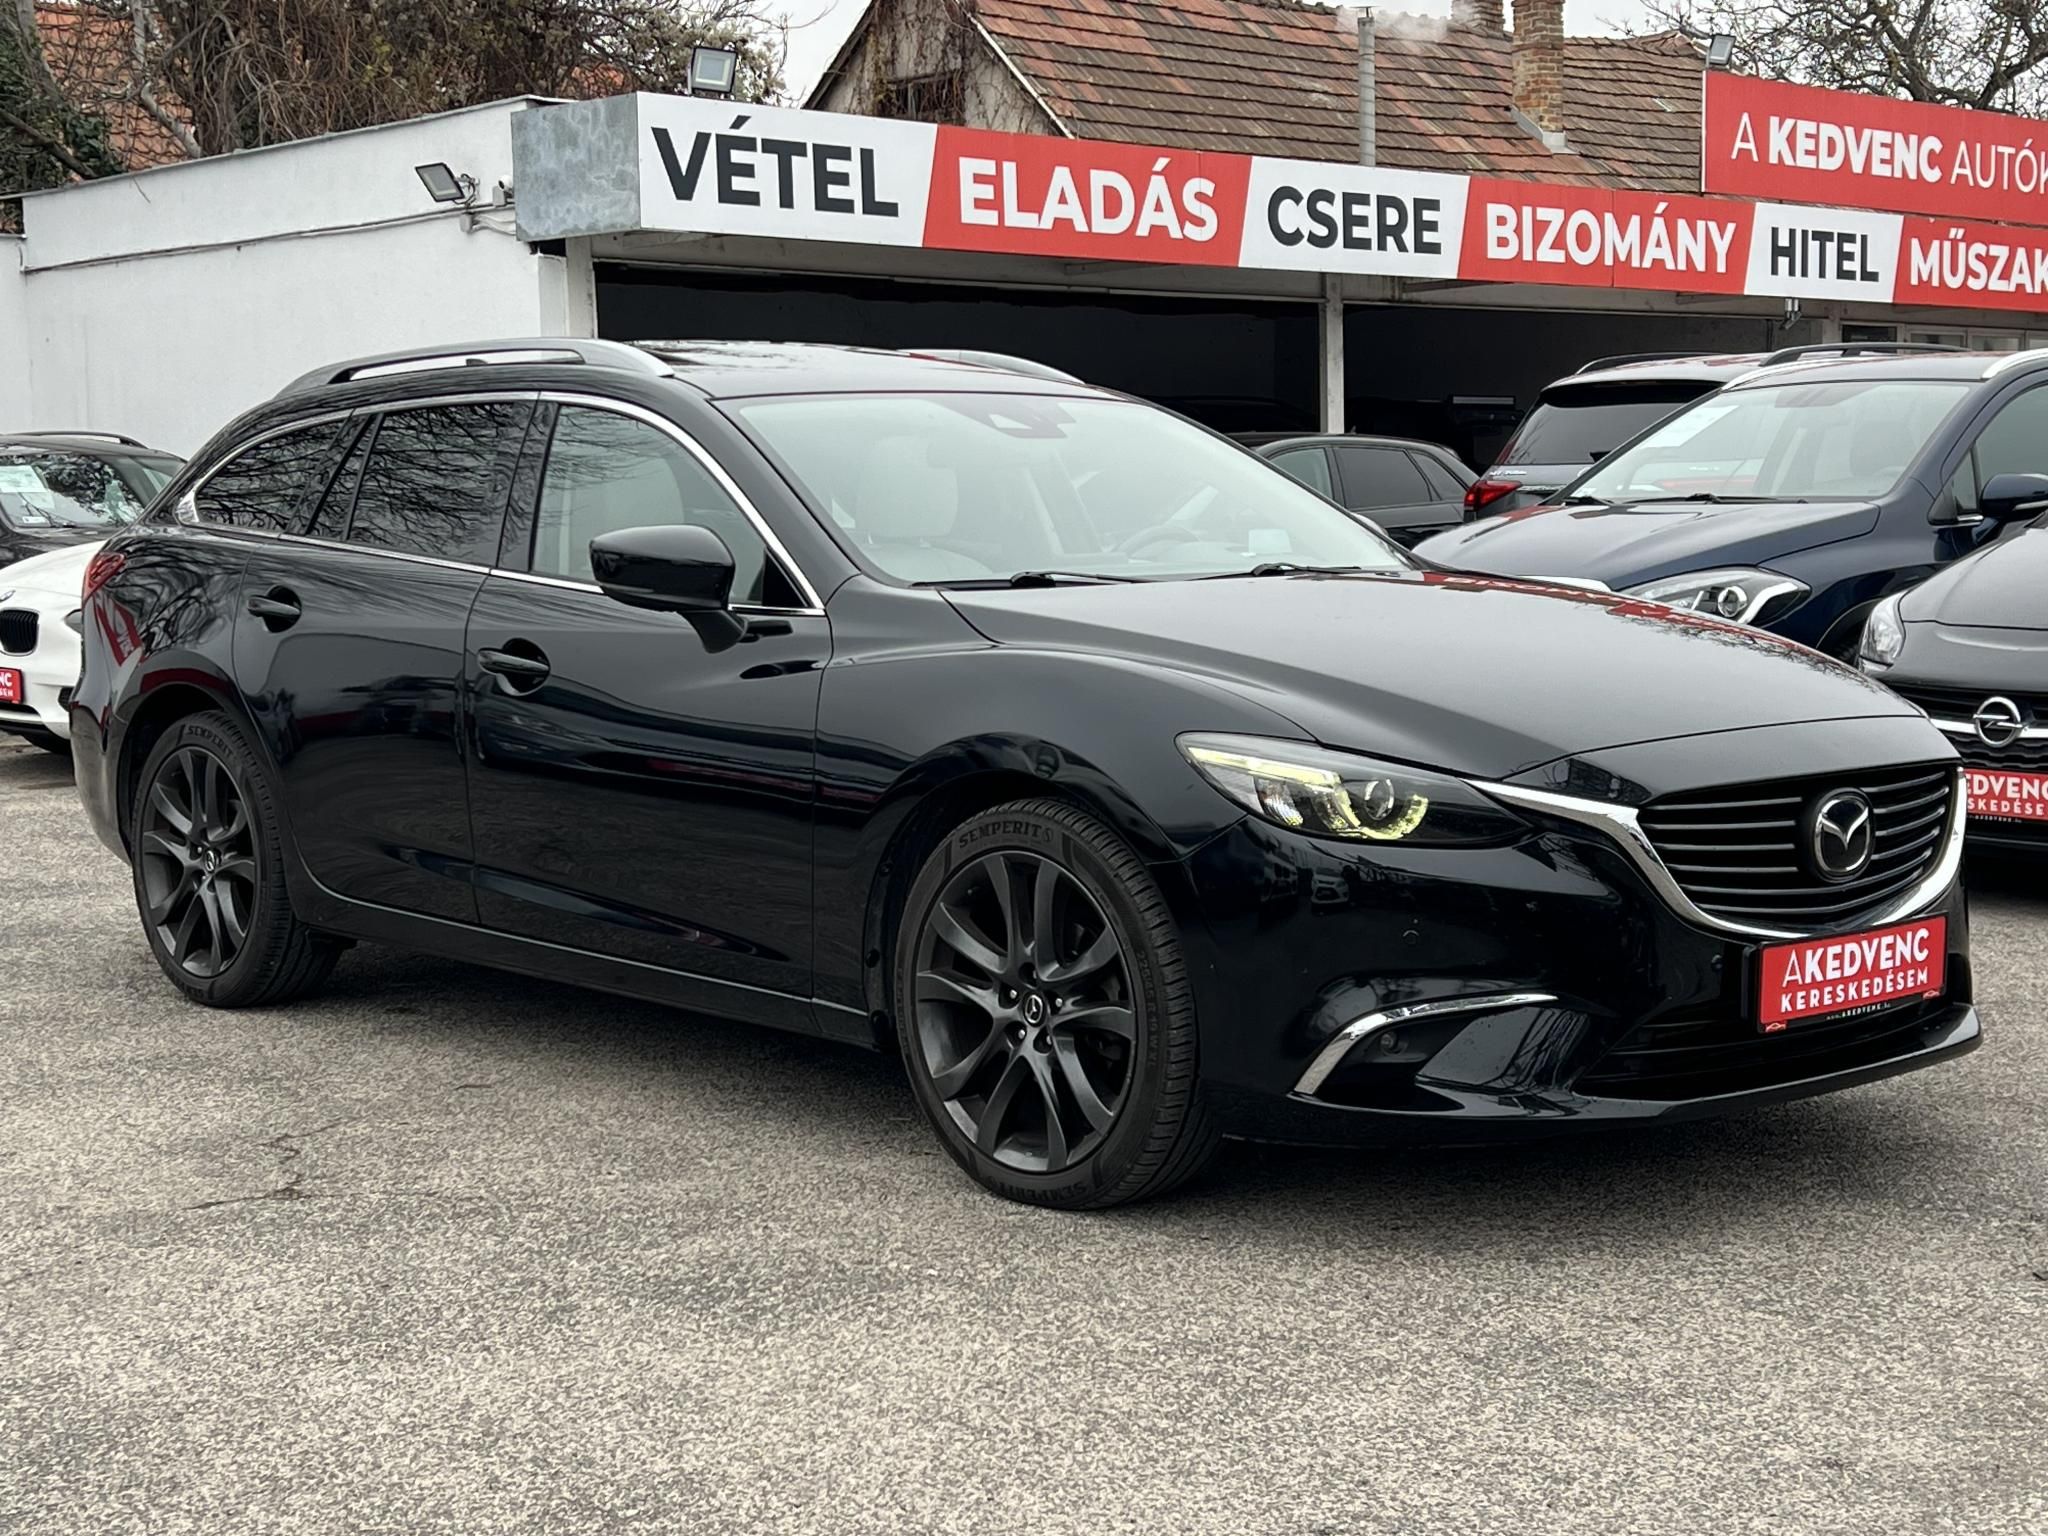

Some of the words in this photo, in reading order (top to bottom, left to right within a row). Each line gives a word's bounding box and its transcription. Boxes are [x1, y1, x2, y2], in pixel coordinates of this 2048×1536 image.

[1731, 112, 1759, 162] A
[1768, 116, 1943, 183] KEDVENC
[651, 115, 899, 217] VÉTEL
[958, 157, 1218, 242] ELADÁS
[1267, 186, 1442, 255] CSERE
[1486, 202, 1736, 274] BIZOMÁNY
[1771, 226, 1879, 283] HITEL
[1910, 227, 2048, 294] MŰSZAK
[958, 820, 1042, 848] SEMPERIT
[1782, 927, 1930, 988] AKEDVENC
[1780, 966, 1928, 1013] KERESKEDÉSEM
